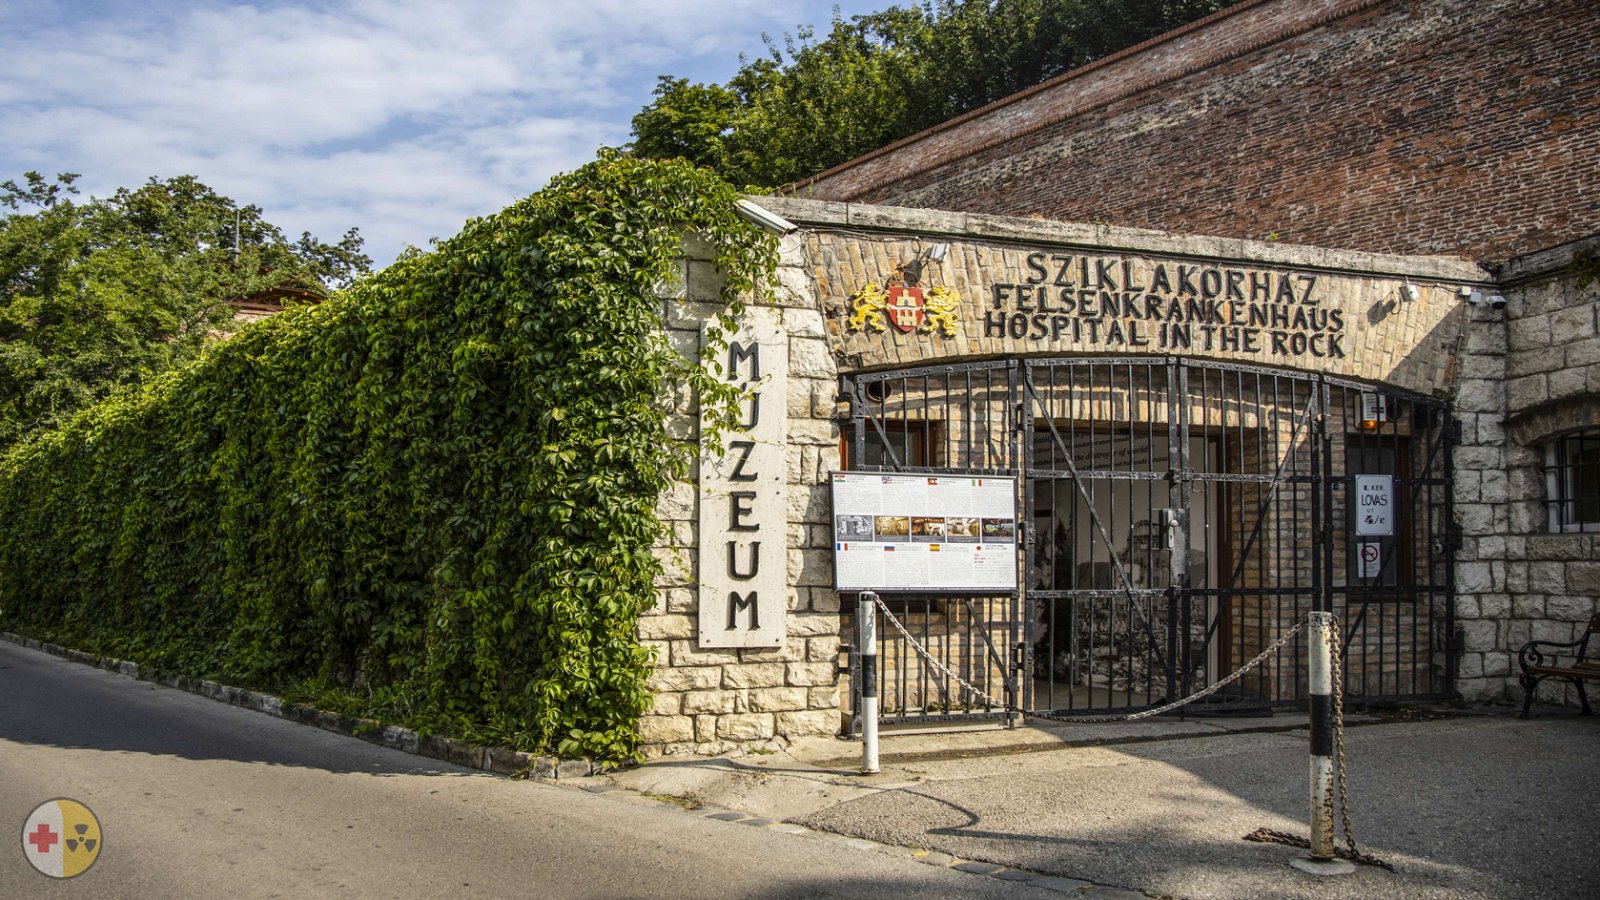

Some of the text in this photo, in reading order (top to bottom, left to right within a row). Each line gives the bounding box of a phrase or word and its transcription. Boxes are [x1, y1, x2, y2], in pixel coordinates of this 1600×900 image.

[991, 283, 1344, 332] FELSENKRANKENHAUS
[984, 310, 1345, 358] HOSPITAL IN THE ROCK
[1118, 448, 1127, 457] of
[1361, 494, 1388, 506] LOVAS
